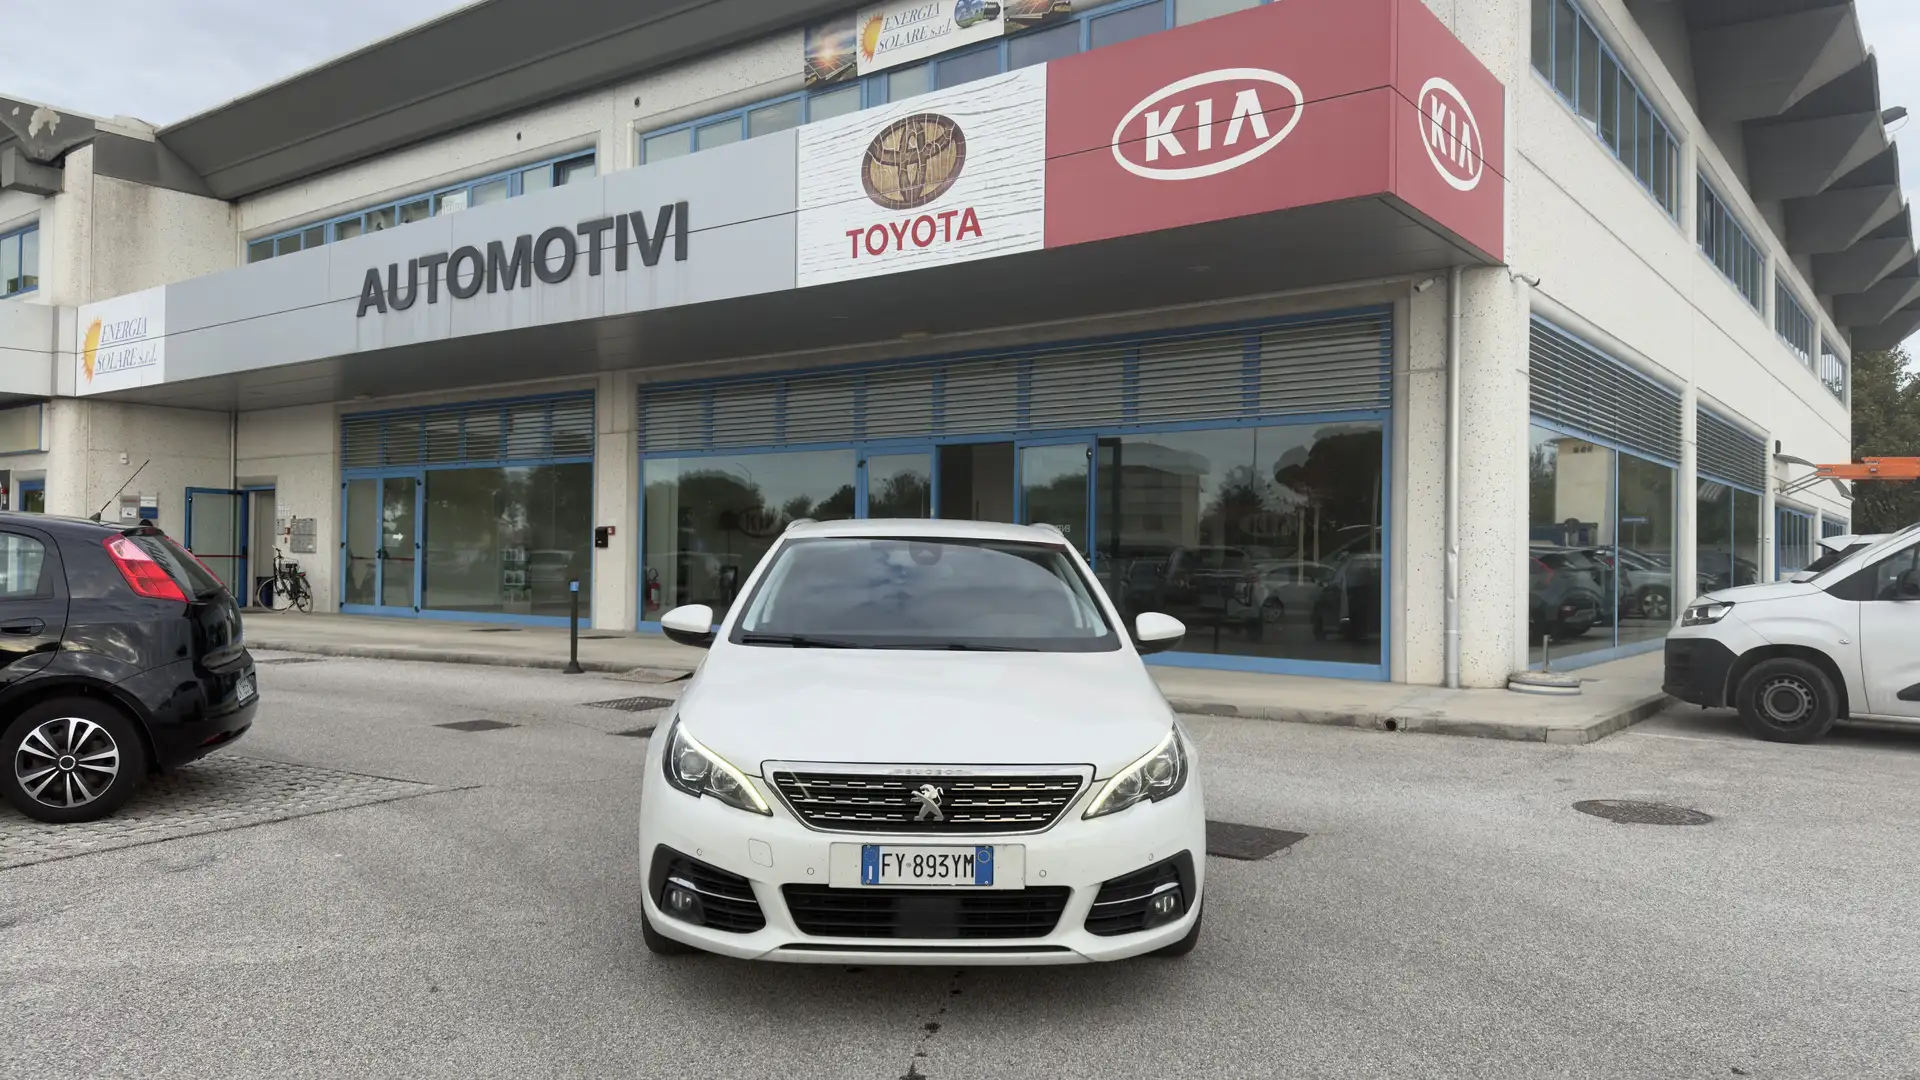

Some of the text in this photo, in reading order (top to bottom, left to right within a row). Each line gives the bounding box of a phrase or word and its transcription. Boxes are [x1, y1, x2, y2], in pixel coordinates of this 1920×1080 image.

[883, 2, 941, 31] ENERGIA
[877, 18, 952, 53] SOLARE s.r.l.
[1144, 88, 1270, 162] KIA
[1431, 93, 1474, 176] KIA
[845, 206, 983, 259] TOYOTA
[356, 200, 689, 318] AUTOMOTIVI
[101, 317, 147, 343] ENERGIA
[95, 347, 138, 372] SOLARE
[881, 853, 906, 877] FY
[912, 854, 975, 878] 893YM
